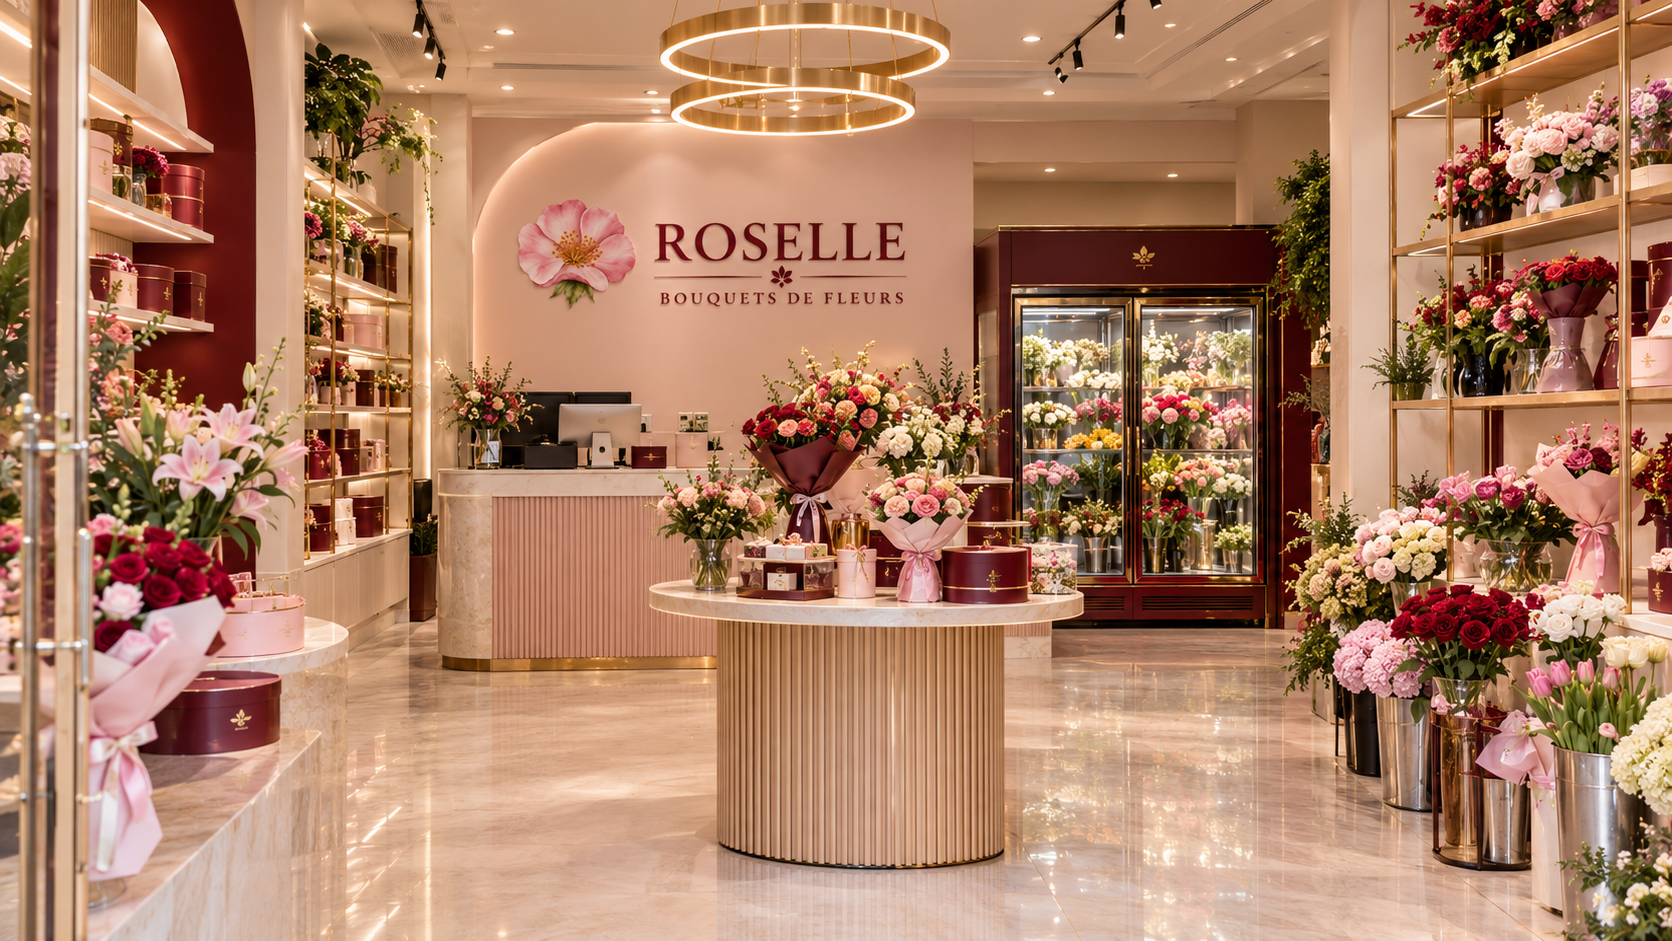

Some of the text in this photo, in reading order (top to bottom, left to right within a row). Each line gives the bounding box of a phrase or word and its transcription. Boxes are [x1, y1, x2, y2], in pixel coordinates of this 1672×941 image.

[655, 222, 906, 262] ROSELLE
[660, 291, 904, 307] BOUQUETS DE FLEURS
